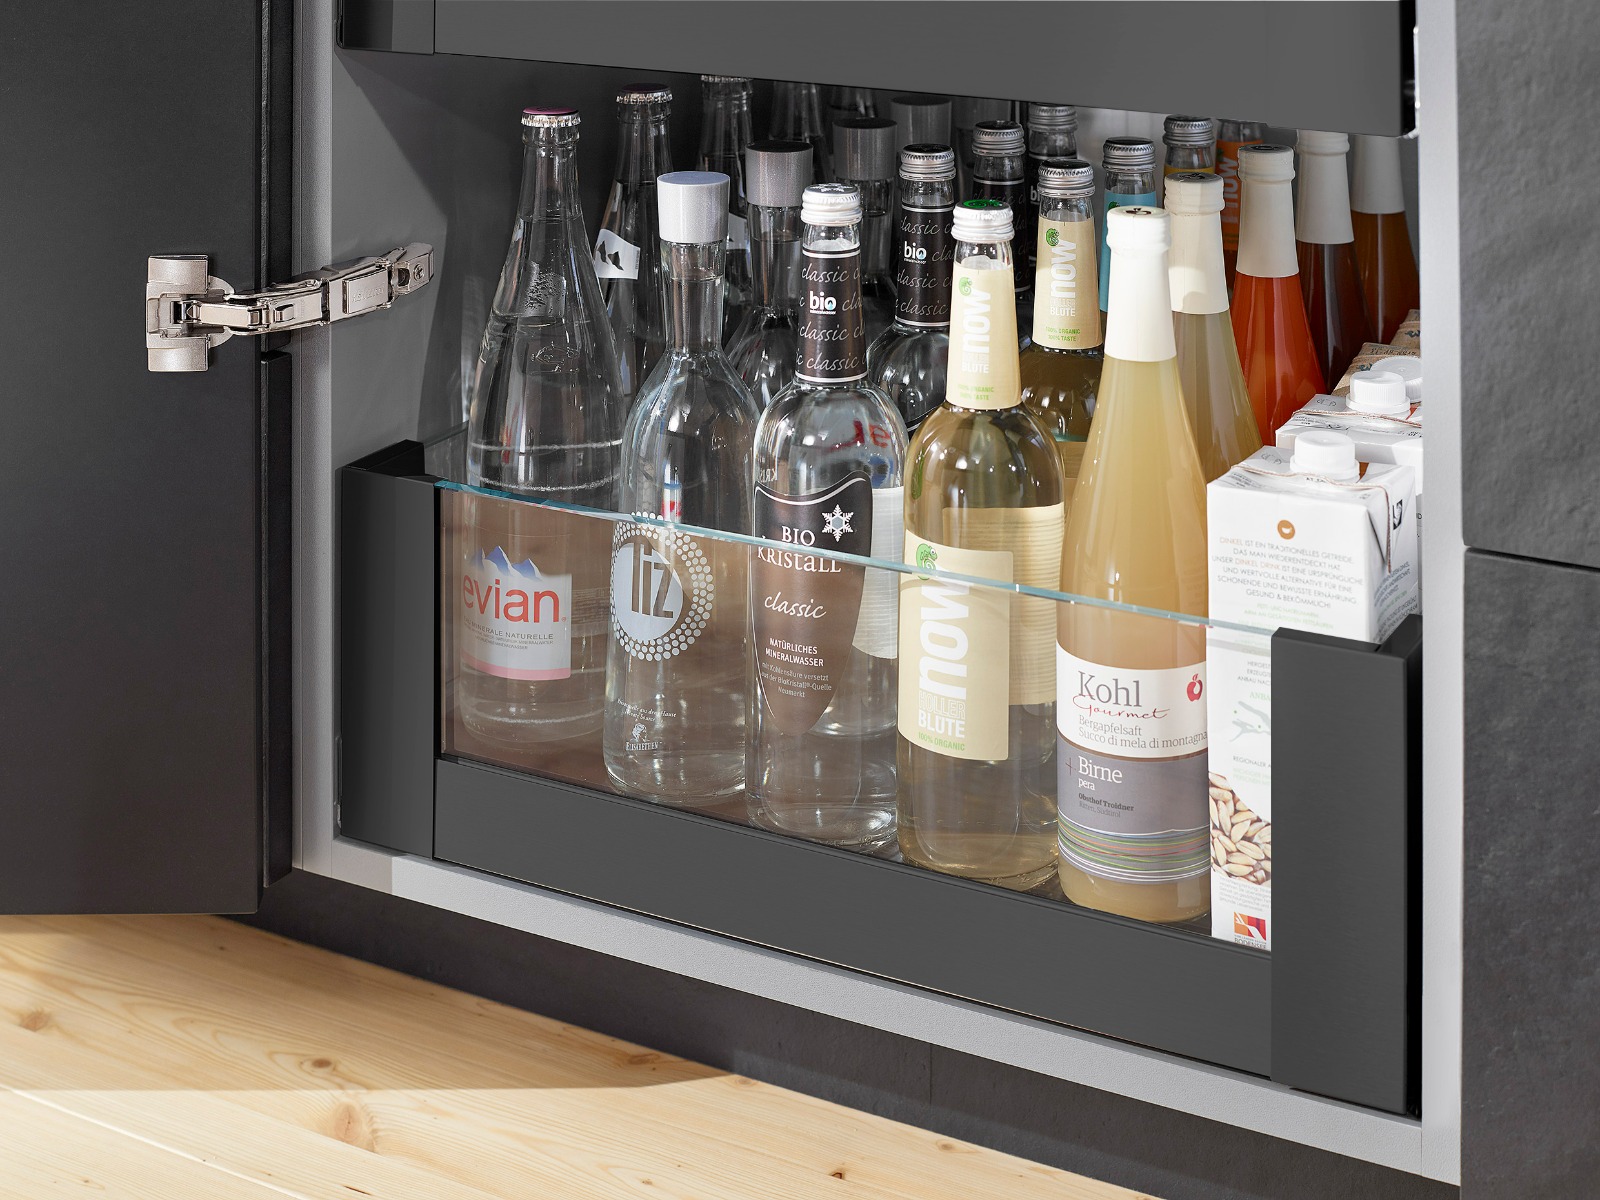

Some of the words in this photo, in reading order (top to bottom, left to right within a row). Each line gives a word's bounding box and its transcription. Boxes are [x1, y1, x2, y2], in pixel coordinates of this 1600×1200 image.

[903, 240, 927, 258] bio
[802, 262, 850, 283] classic
[1050, 239, 1077, 299] now
[809, 290, 837, 310] bio
[800, 321, 850, 341] classic
[962, 288, 992, 354] now
[806, 352, 860, 371] classic
[781, 526, 816, 547] BIO
[1219, 537, 1244, 547] DINKEL
[1255, 541, 1266, 549] EIN
[1233, 548, 1247, 556] DAS
[1250, 550, 1266, 558] MAN
[1212, 555, 1234, 564] UNSER
[1235, 558, 1258, 567] DINKEL
[1292, 567, 1307, 576] EINE
[1223, 567, 1239, 575] UND
[1240, 569, 1279, 581] WERTVOLLE
[1246, 589, 1275, 599] GESUND
[1263, 582, 1278, 590] UND
[463, 575, 560, 623] evian
[764, 591, 827, 619] classic
[505, 632, 554, 640] NATURELLE
[769, 637, 818, 655] NATÜRLICHES
[765, 647, 824, 667] MINERALWASSER
[803, 673, 829, 682] versetzt
[1078, 671, 1142, 708] Kohl
[1072, 694, 1170, 720] Gourmet
[918, 711, 966, 739] BLÜTE
[1078, 715, 1142, 736] Bergapfelsaft
[918, 731, 933, 744] 100%
[934, 739, 965, 752] ORGANIC
[1078, 727, 1106, 745] Succo
[1108, 734, 1118, 747] di
[1120, 736, 1147, 749] mela
[1149, 735, 1160, 749] di
[1162, 730, 1207, 748] montagna
[1078, 755, 1123, 784] Birne
[1078, 778, 1095, 791] pera
[1078, 792, 1102, 806] Obsthof
